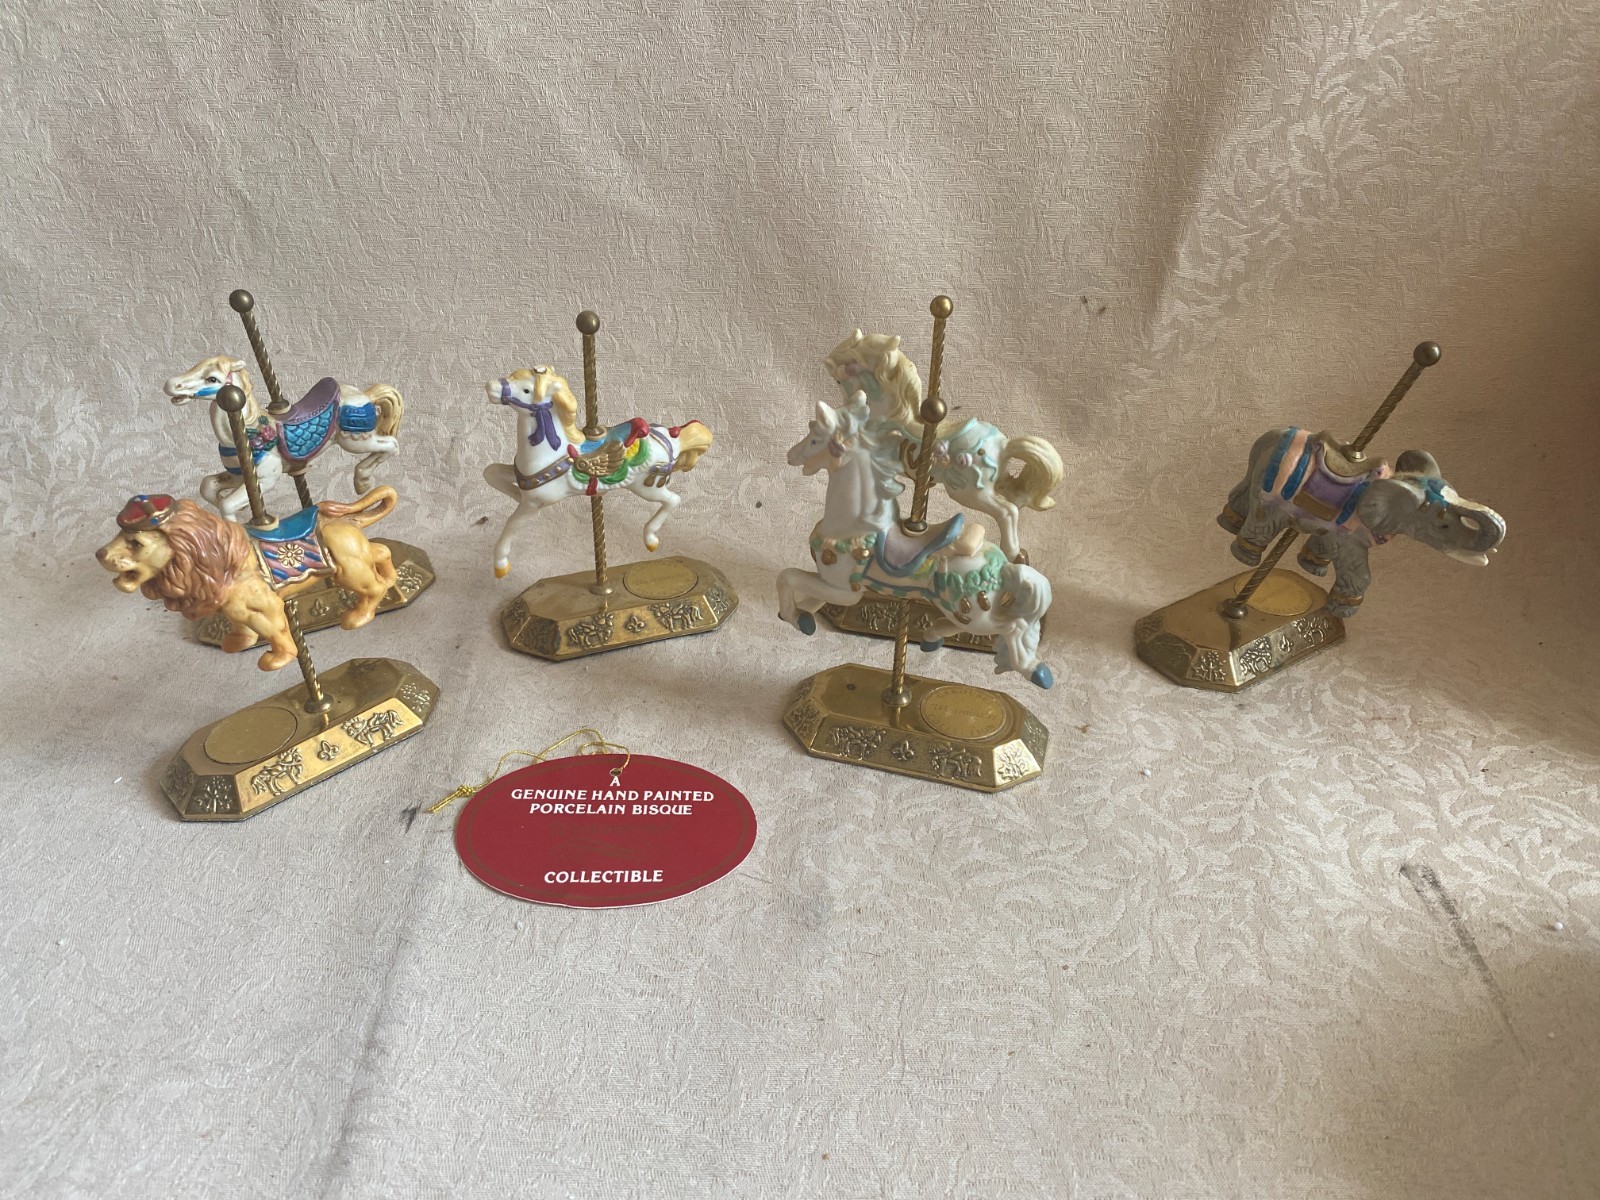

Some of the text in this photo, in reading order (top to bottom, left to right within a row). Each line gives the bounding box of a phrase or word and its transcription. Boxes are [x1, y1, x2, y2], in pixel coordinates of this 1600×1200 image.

[610, 776, 620, 786] A
[511, 789, 714, 801] GENUINE HAND PAINTED
[529, 803, 692, 815] PORCELAIN BISQUE
[544, 870, 664, 883] COLLECTIBLE
